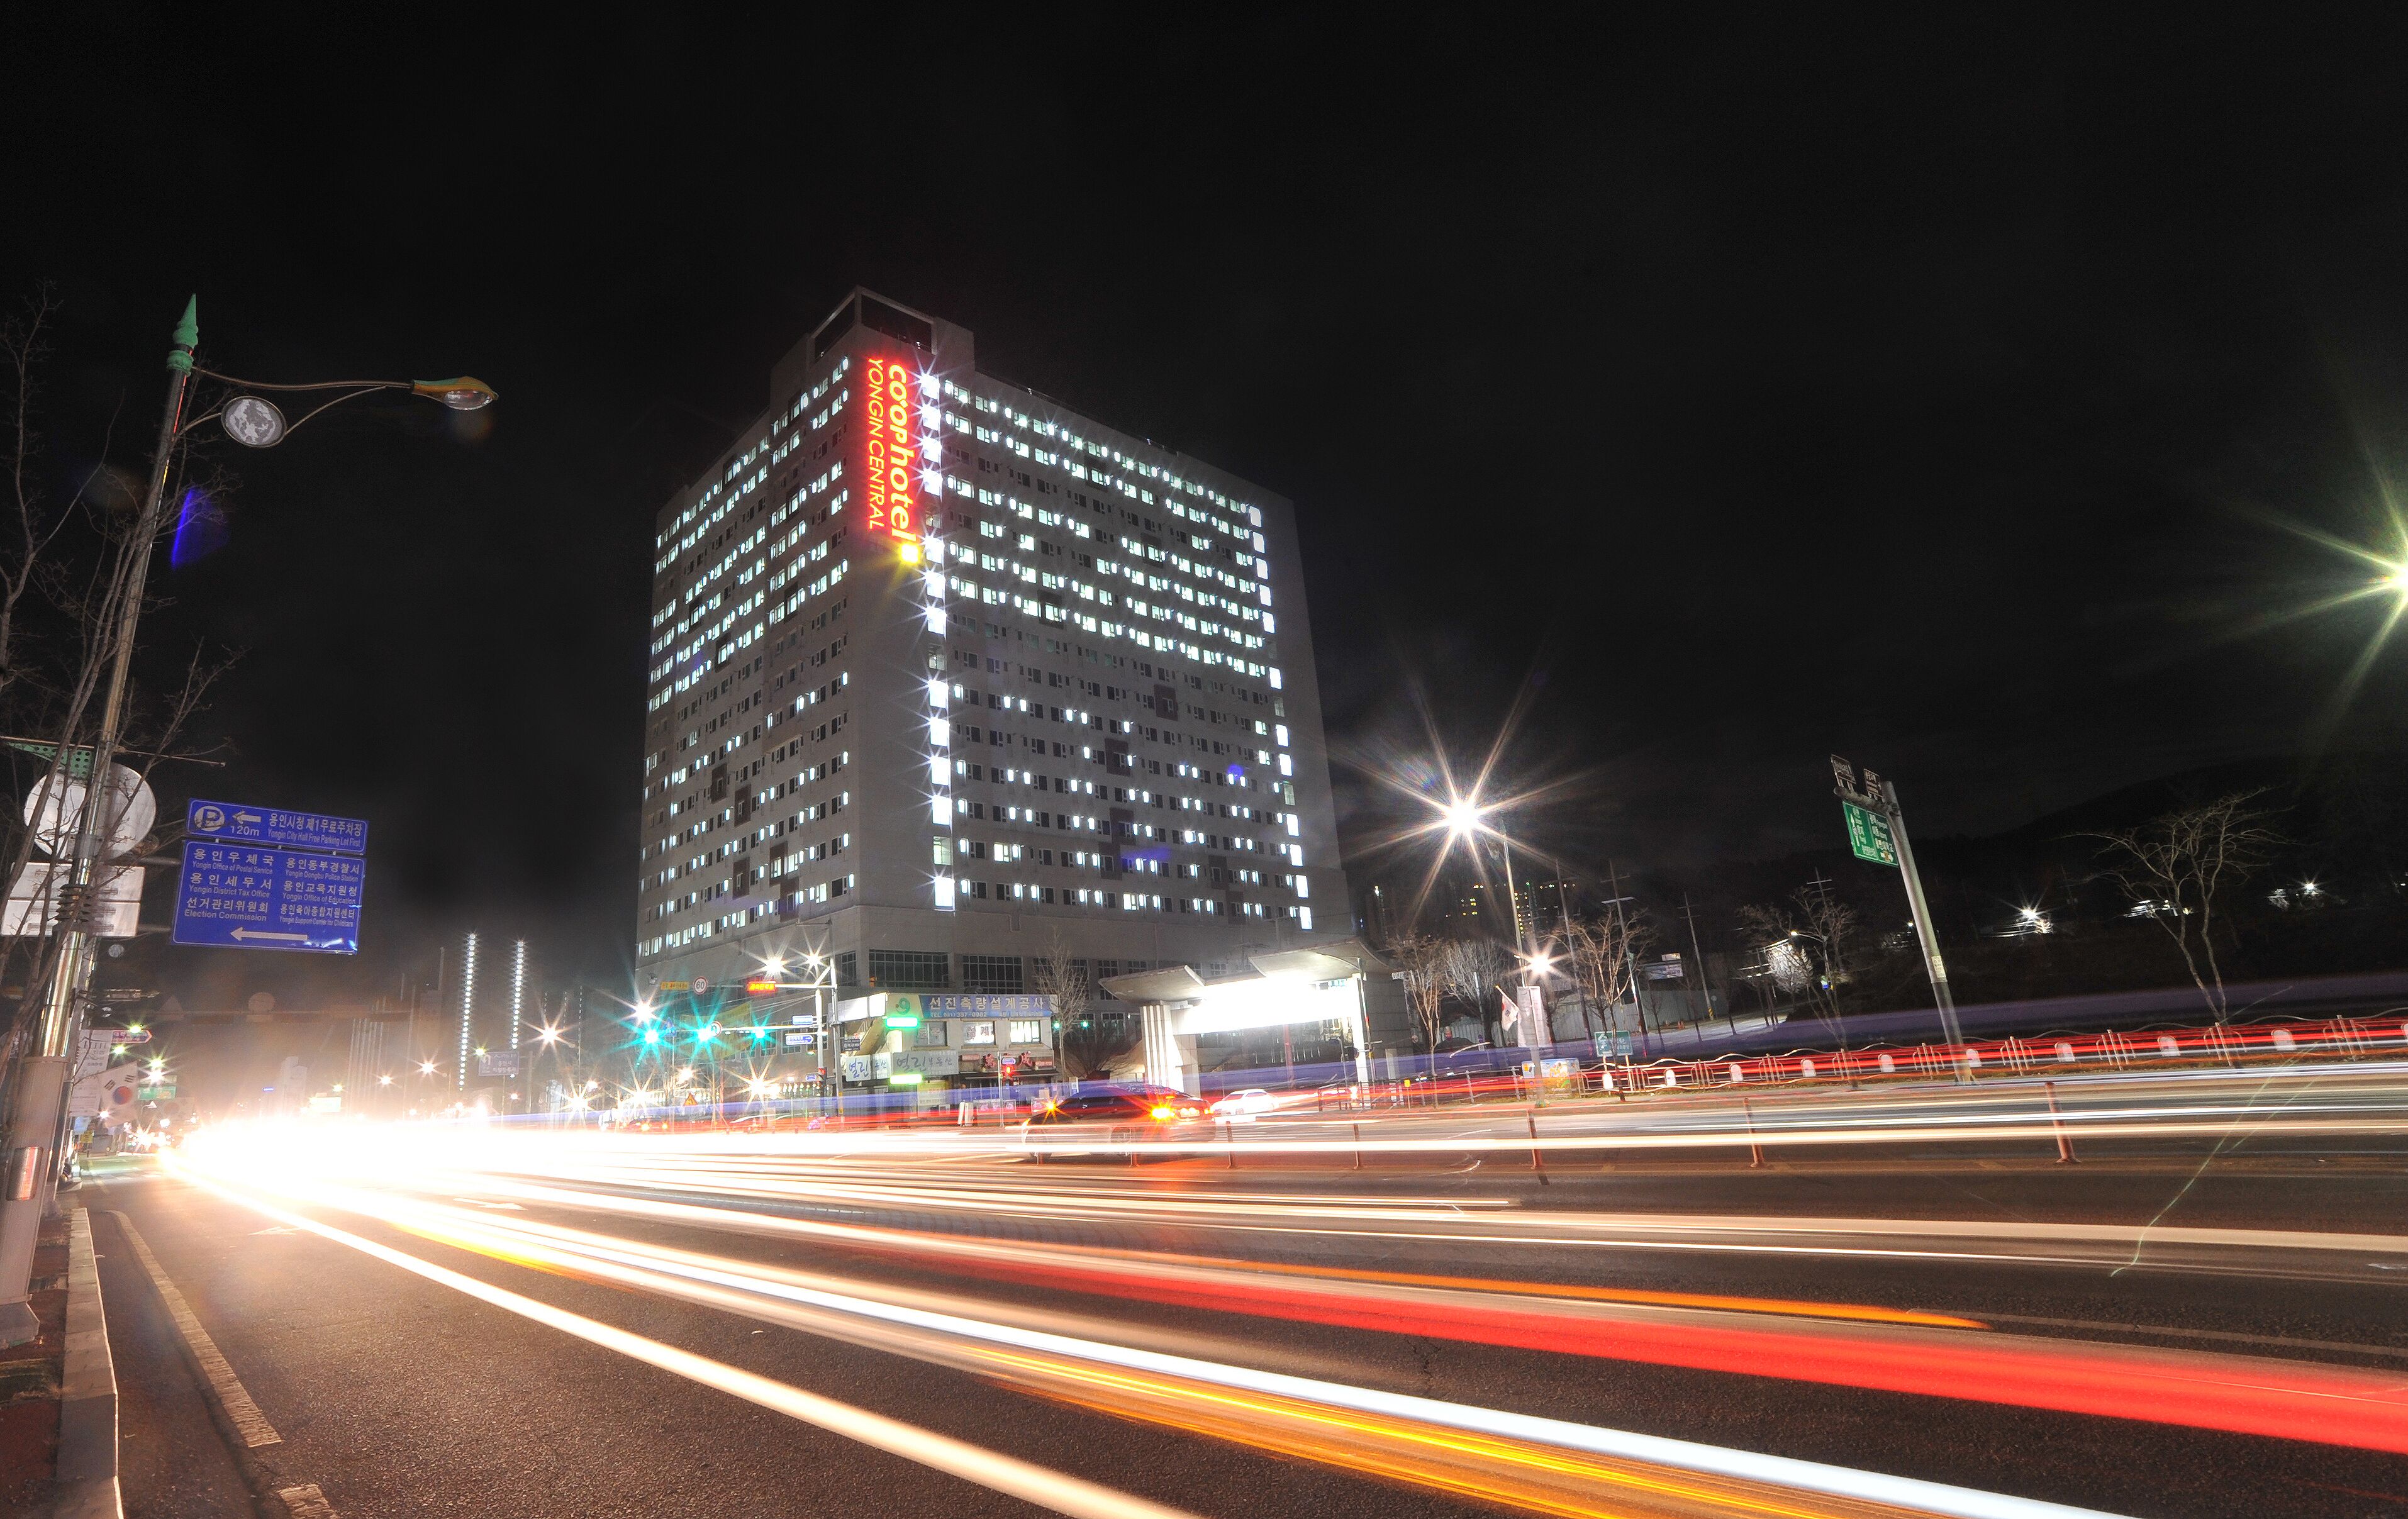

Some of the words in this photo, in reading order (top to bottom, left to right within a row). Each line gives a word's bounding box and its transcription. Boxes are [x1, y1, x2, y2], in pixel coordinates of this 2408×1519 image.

[868, 358, 884, 438] YONGIN
[869, 440, 885, 530] CENTRAL
[231, 825, 260, 837] 120m
[269, 813, 304, 830] 용인시청
[306, 818, 362, 837] 제1무료주차장
[192, 860, 211, 871] Yongin
[213, 862, 229, 871] Office
[194, 849, 275, 866] 용인우체국
[286, 857, 360, 874] 용인동부경찰서
[190, 872, 272, 890] 용인세무서
[286, 869, 303, 878] Yongin
[341, 874, 359, 882] Station
[189, 885, 212, 894] Yongin
[214, 887, 237, 896] District
[251, 889, 270, 898] Office
[284, 880, 357, 897] 용인교육지원청
[186, 897, 268, 913] 선거관리위원회
[283, 893, 303, 901] Yongin
[184, 910, 216, 918] Election
[219, 911, 267, 921] Commission
[930, 996, 1044, 1010] 선진측량설계공사
